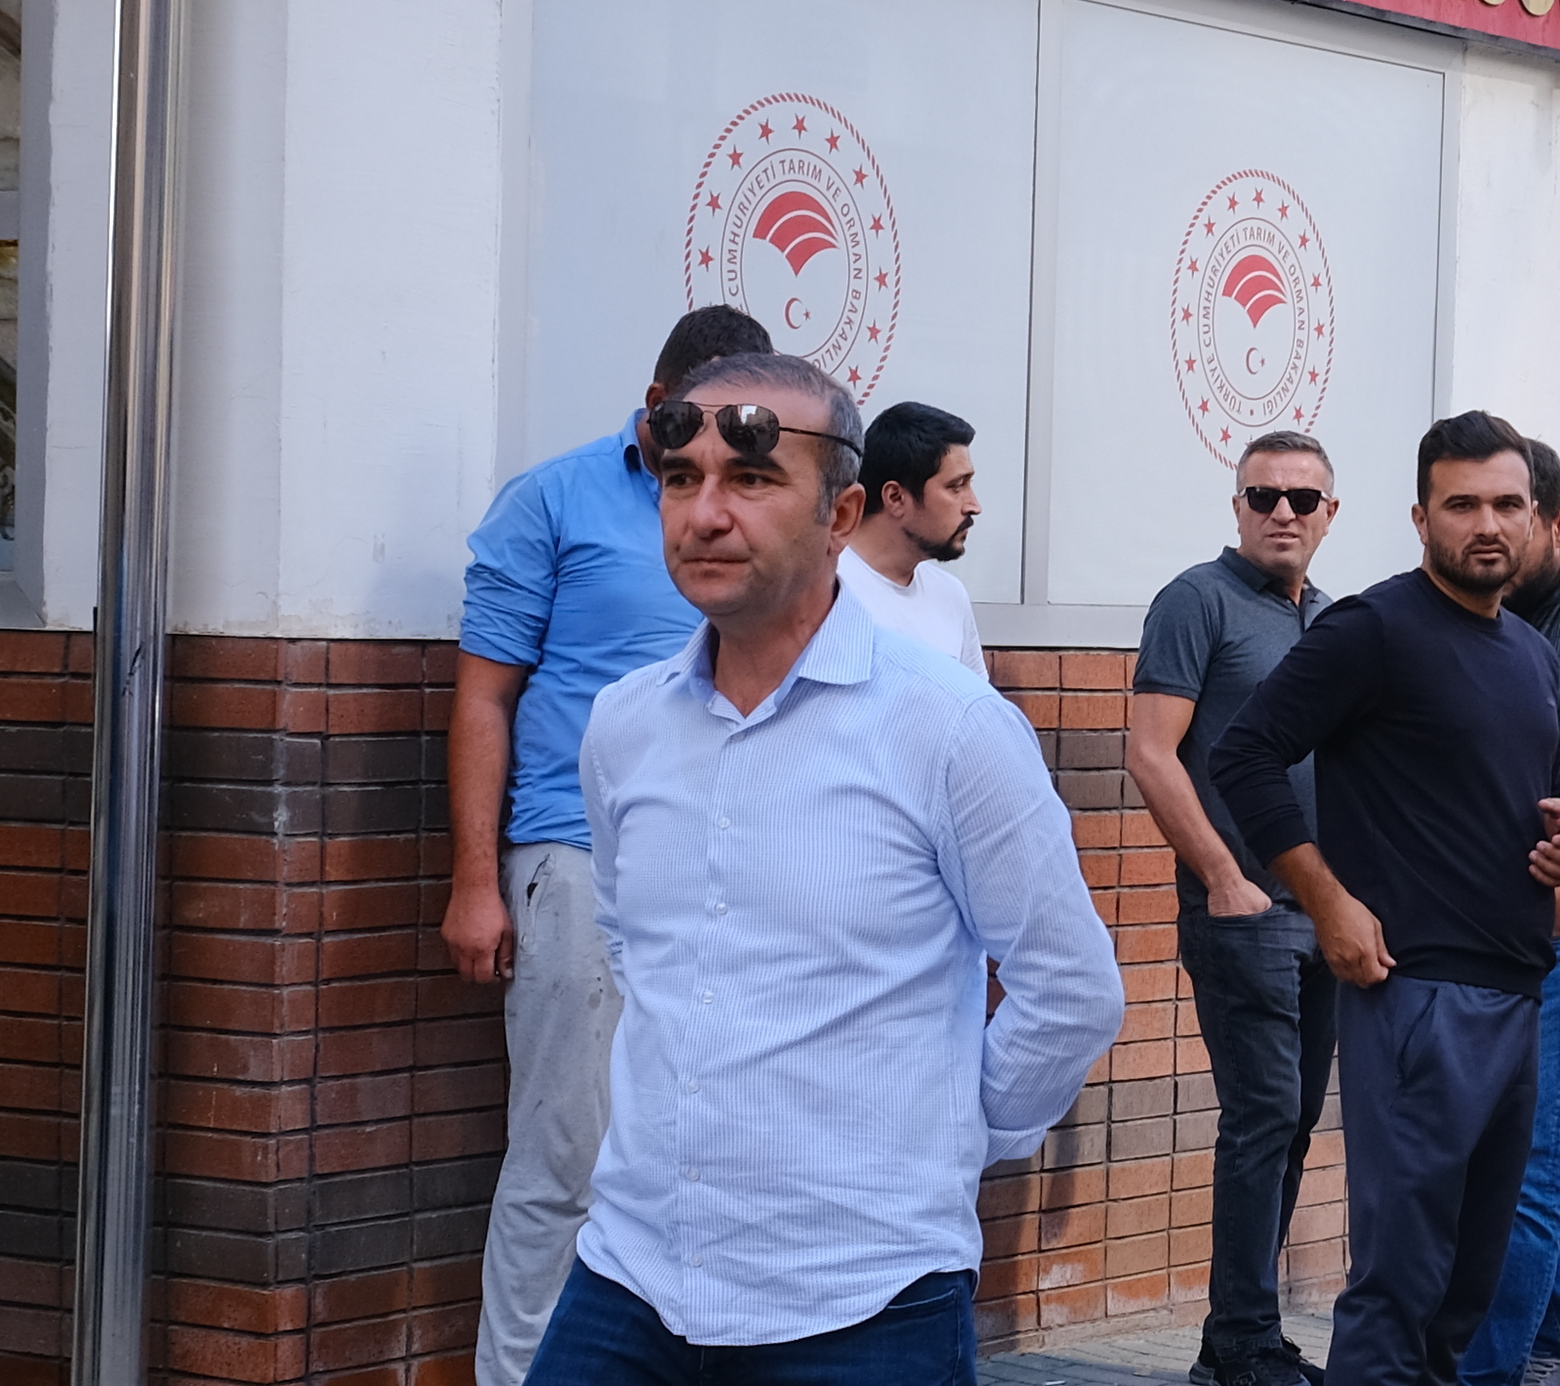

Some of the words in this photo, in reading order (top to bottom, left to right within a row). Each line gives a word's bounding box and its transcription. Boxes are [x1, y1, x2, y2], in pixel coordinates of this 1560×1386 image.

[727, 160, 776, 297] CUMHURİYETİ
[779, 159, 822, 183] TARIM
[824, 176, 841, 203] VE
[841, 203, 863, 280] ORMAN
[1242, 226, 1276, 248] TARIM
[1278, 240, 1290, 262] VE
[1202, 229, 1241, 348] CUMHURİYETİ
[1289, 264, 1305, 331] ORMAN
[1207, 353, 1242, 413] TÜRKİYE
[1262, 338, 1305, 417] BAKANLIĞI
